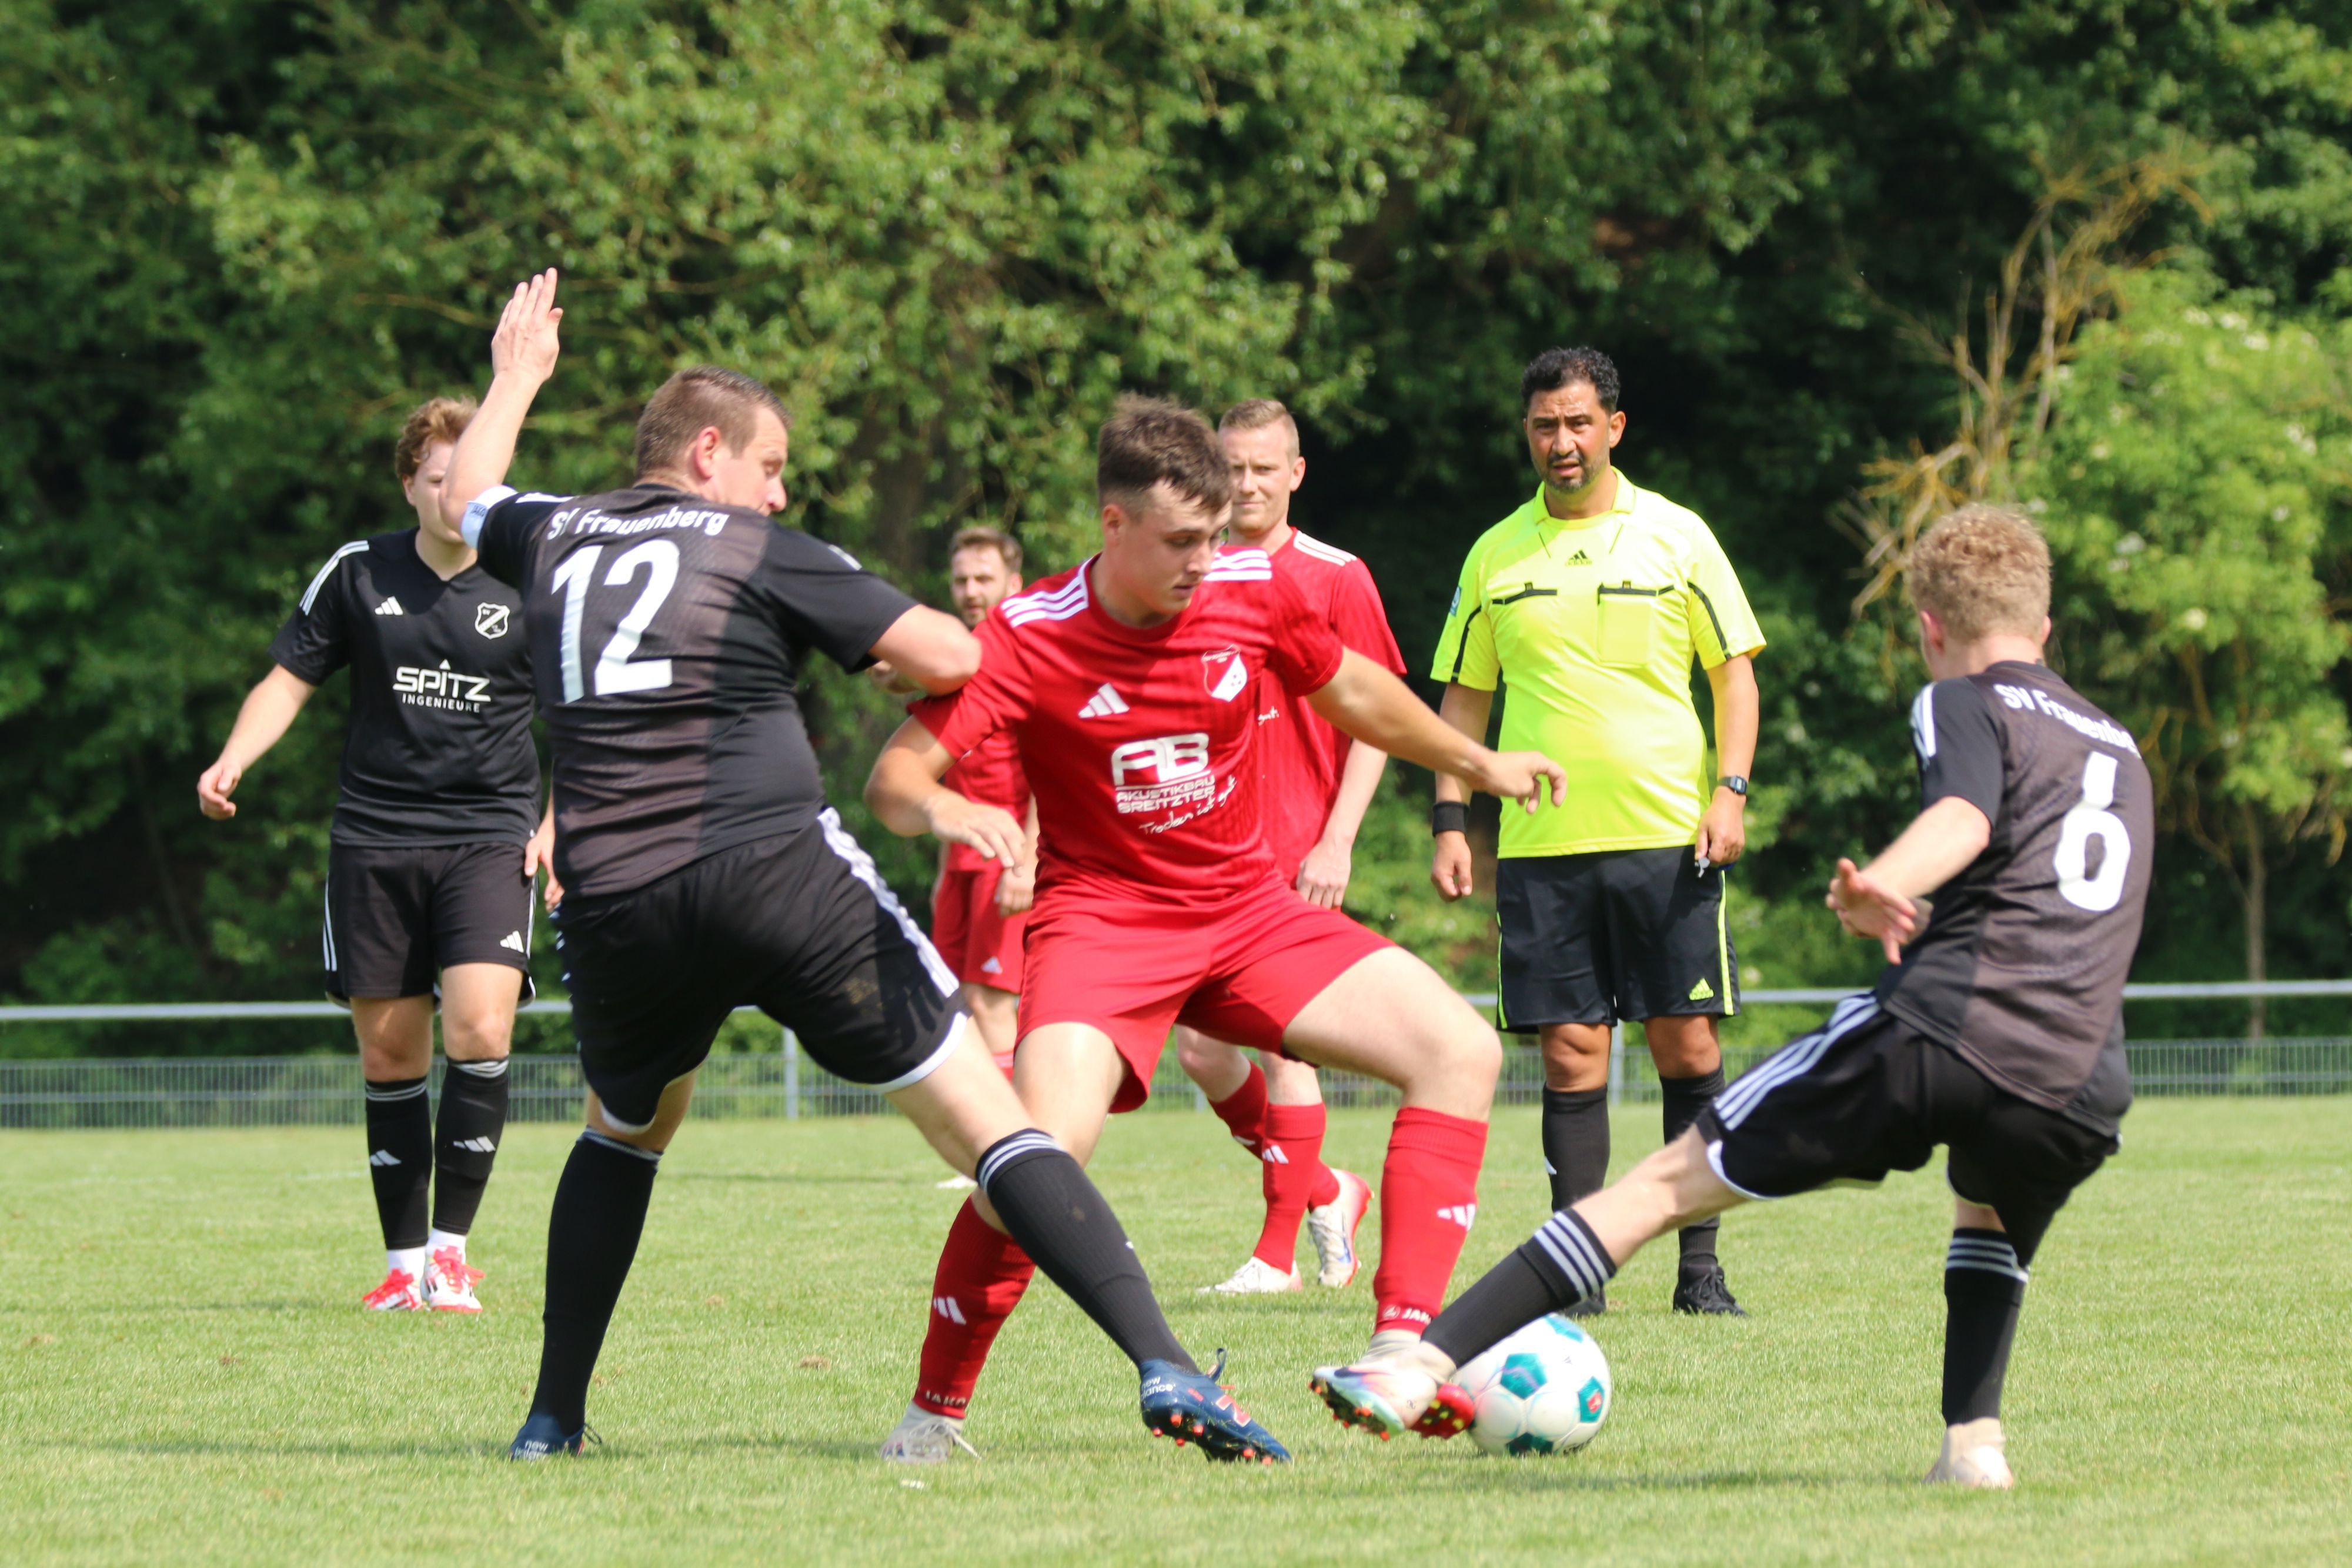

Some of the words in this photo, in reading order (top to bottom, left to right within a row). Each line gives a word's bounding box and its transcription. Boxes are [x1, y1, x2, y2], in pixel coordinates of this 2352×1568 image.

[574, 506, 730, 536] Frauenberg
[551, 539, 680, 704] 12
[393, 659, 491, 702] SPITZ
[1993, 684, 2036, 711] SV
[402, 693, 480, 713] INGENIEURE
[1111, 733, 1209, 785] AB
[1117, 774, 1215, 803] AKUSTIKBAU
[2053, 751, 2132, 912] 6
